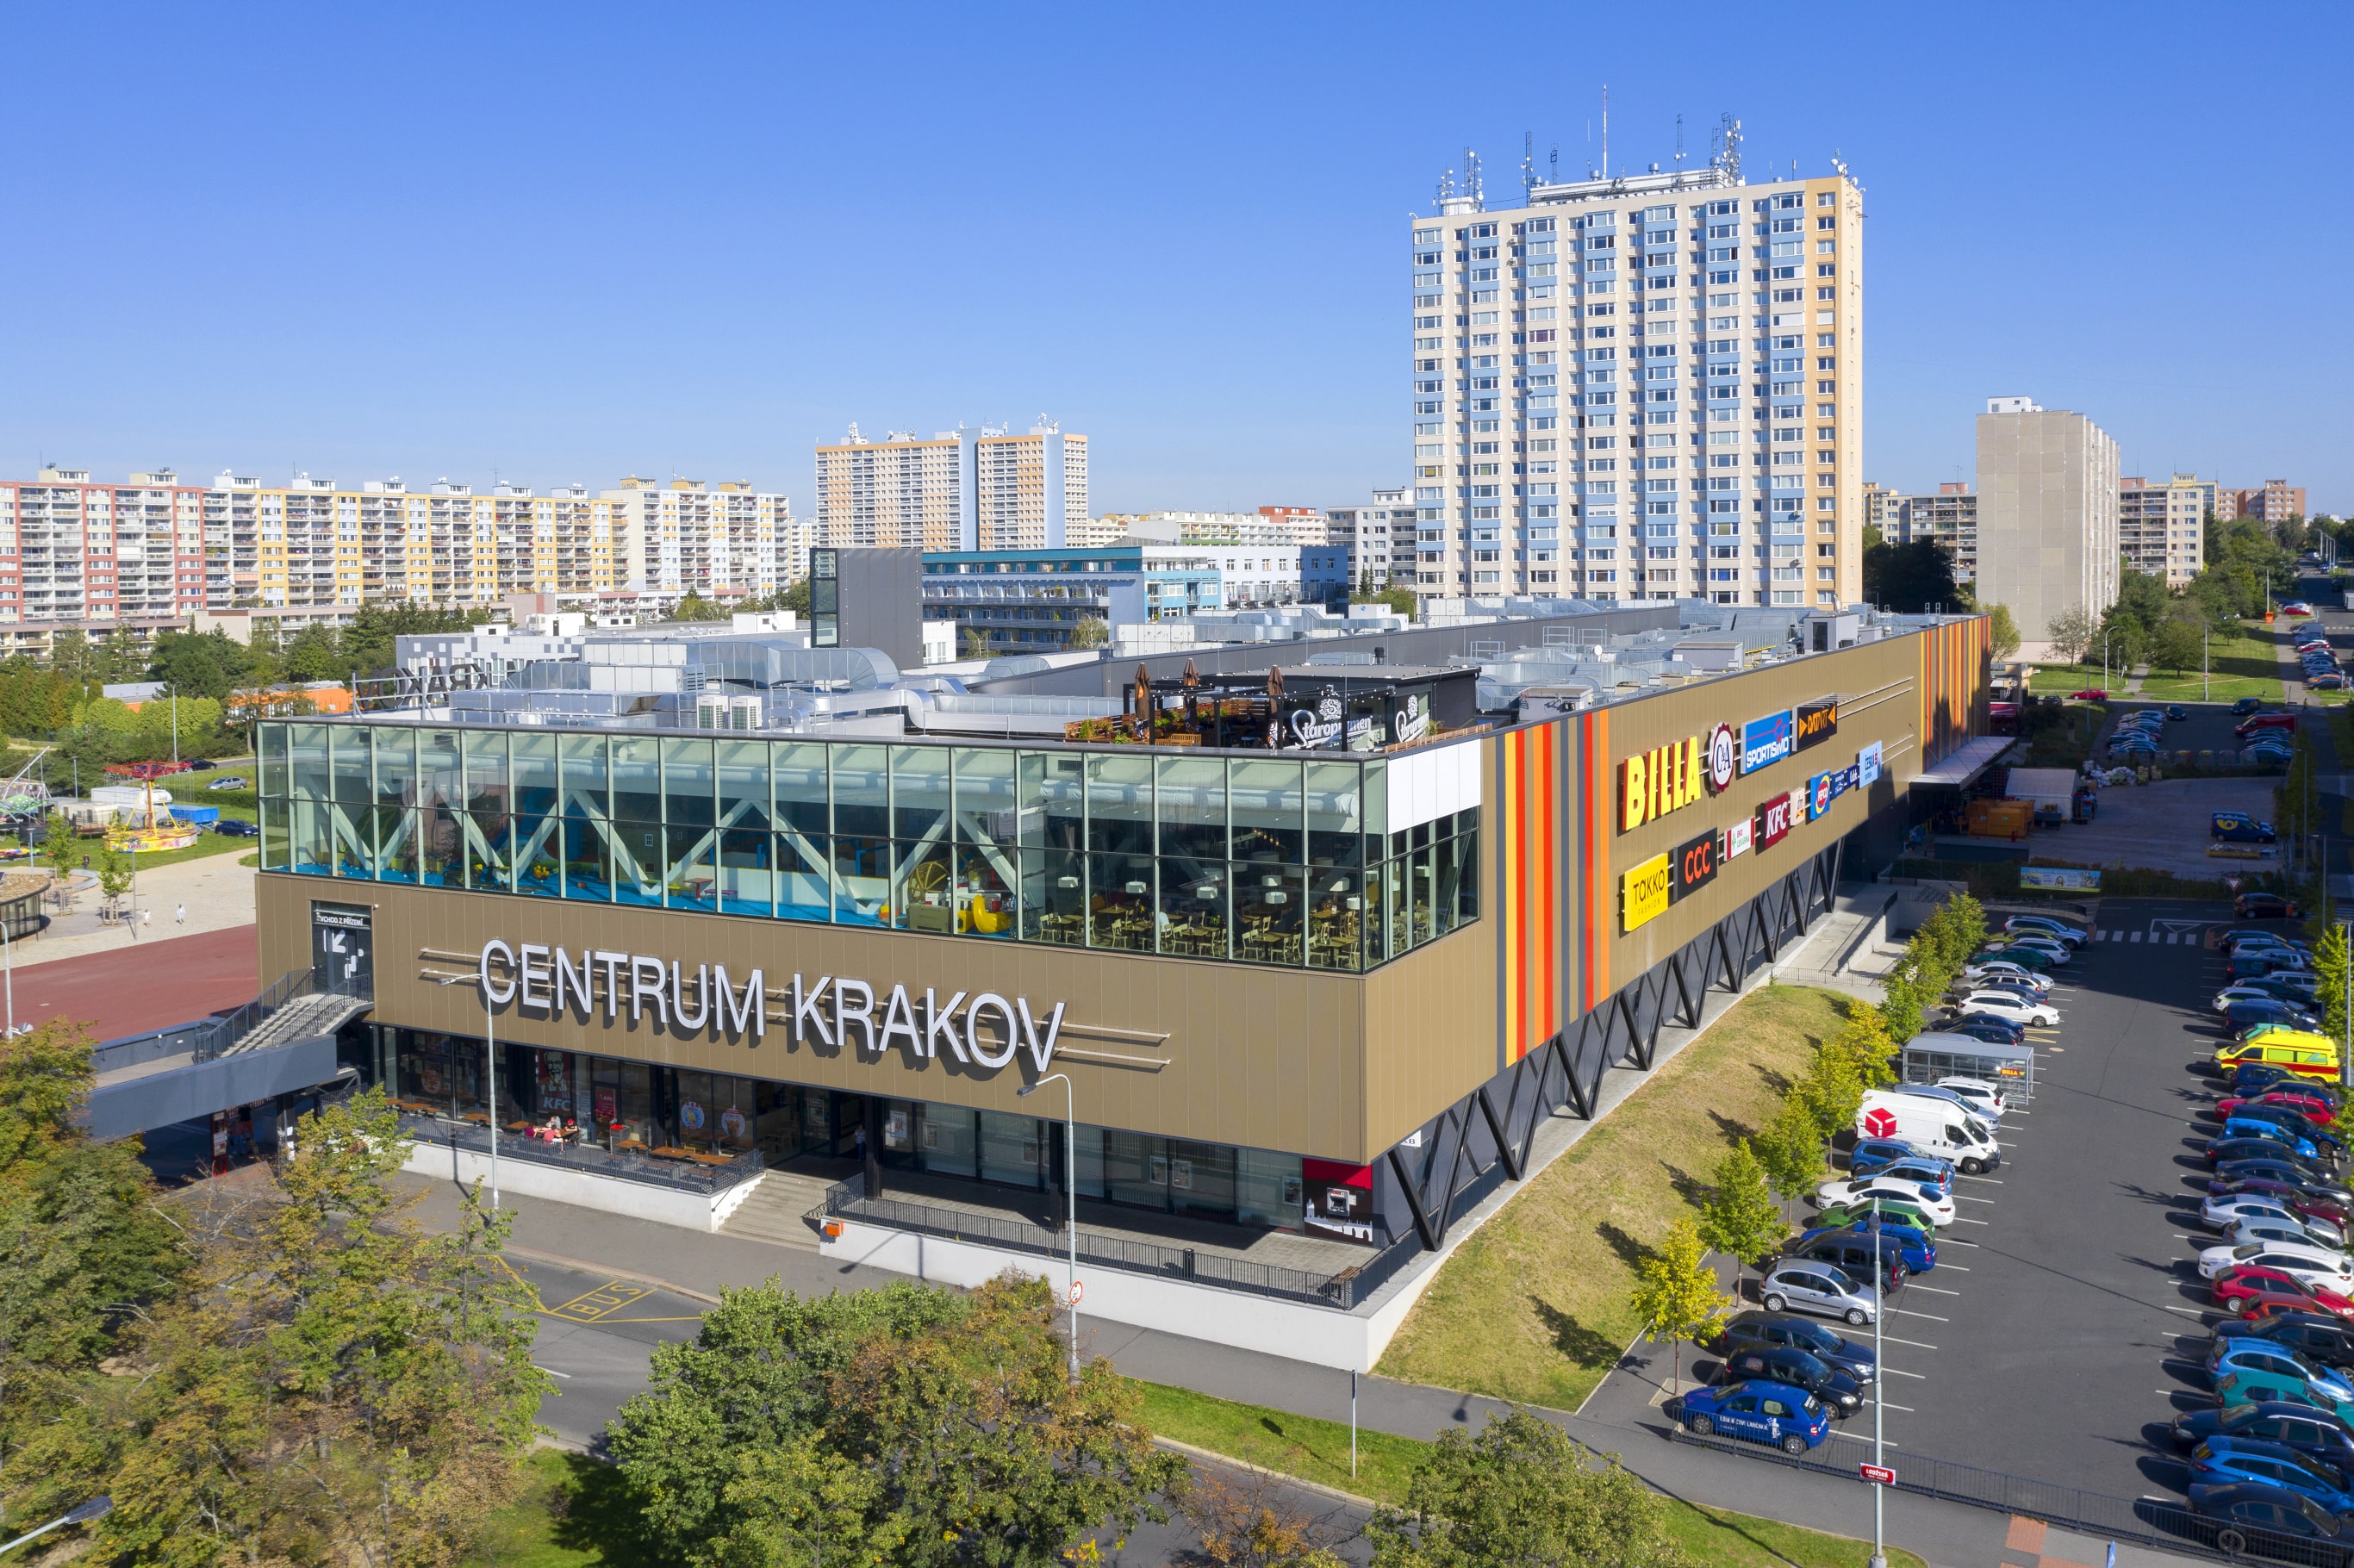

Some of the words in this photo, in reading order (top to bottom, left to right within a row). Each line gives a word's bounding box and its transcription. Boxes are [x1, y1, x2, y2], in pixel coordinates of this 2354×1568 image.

[1716, 741, 1730, 773] C&A
[1747, 737, 1790, 768] SPORTISIMO
[1624, 736, 1701, 831] BILLA
[1766, 801, 1787, 839] KFC
[1685, 842, 1710, 884] CCC
[480, 939, 765, 1036] CENTRUM
[794, 973, 1067, 1072] KRAKOV
[543, 1096, 571, 1111] KFC
[568, 1285, 642, 1316] BUS
